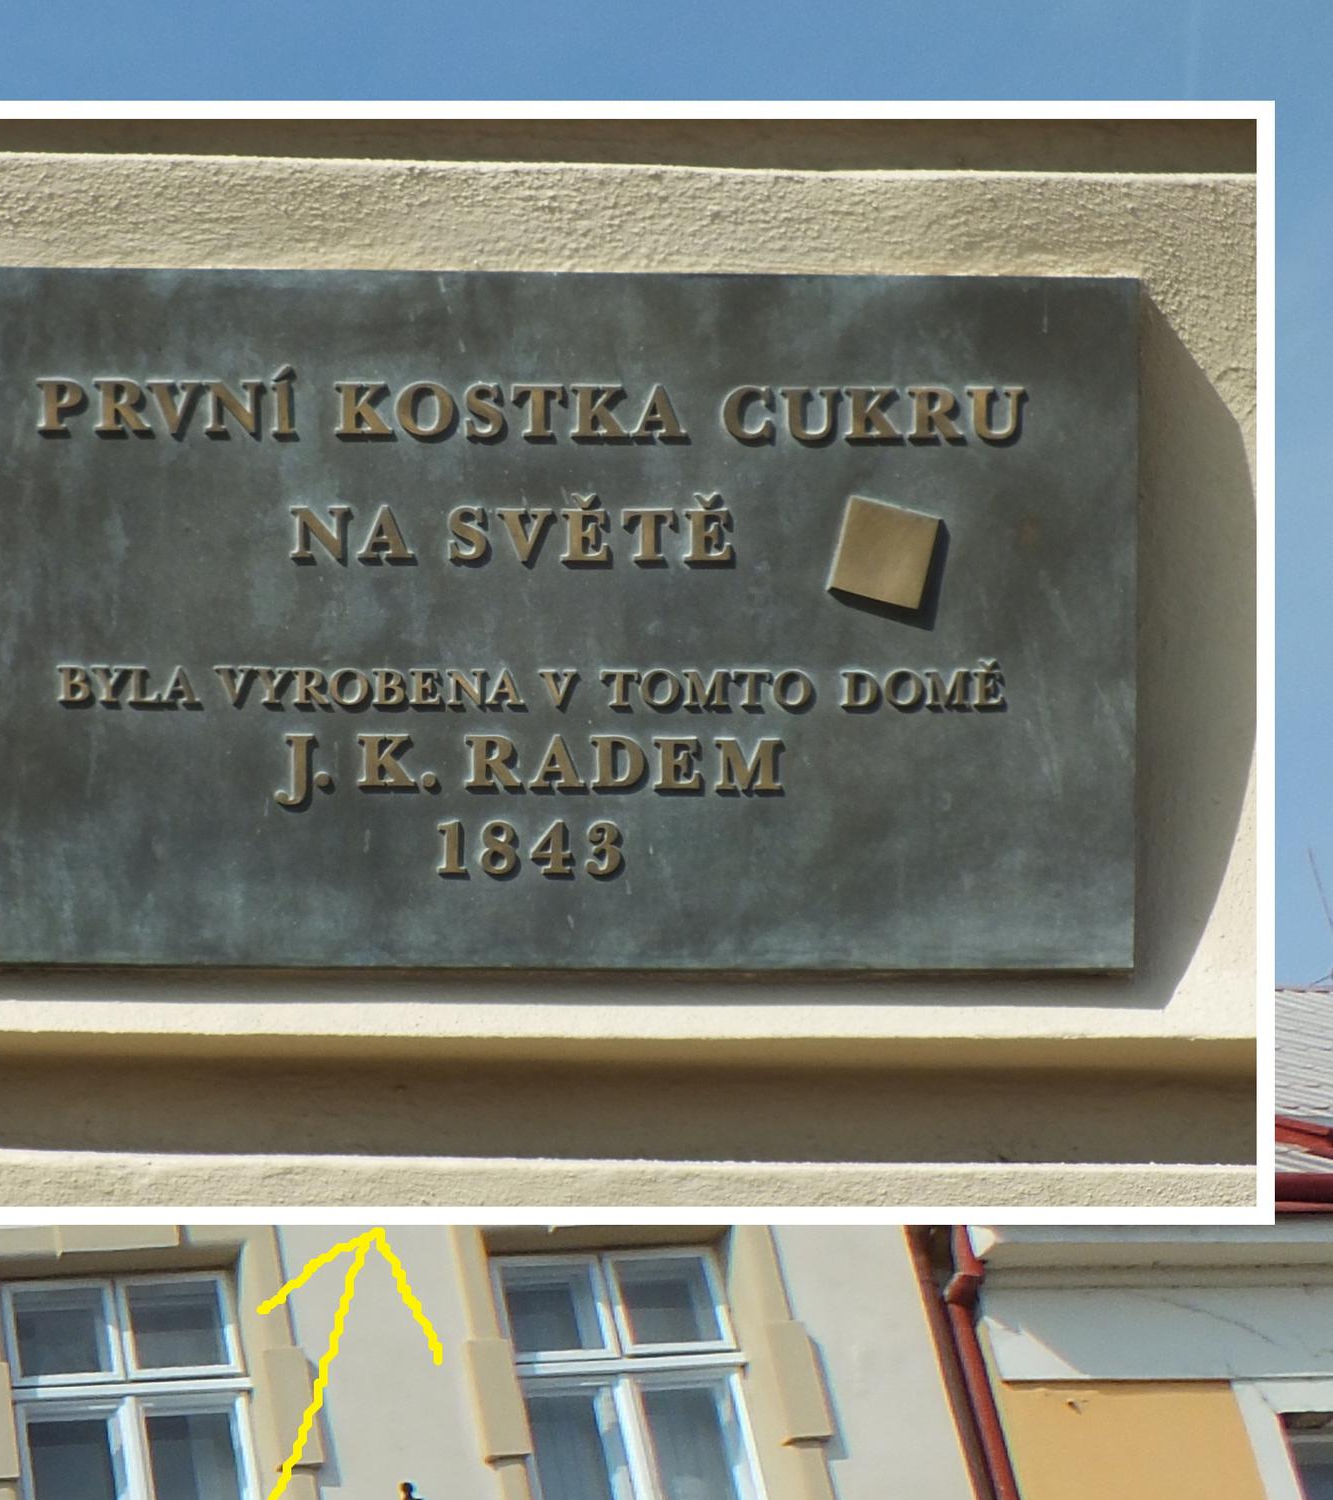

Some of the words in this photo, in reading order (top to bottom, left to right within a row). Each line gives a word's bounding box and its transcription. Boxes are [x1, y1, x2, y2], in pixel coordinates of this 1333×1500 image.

[36, 364, 296, 440] PRVNÍ
[334, 380, 688, 443] KOSTKA
[721, 385, 1027, 445] CUKRU
[290, 504, 416, 564] NA
[447, 491, 734, 567] SVĚTĚ
[56, 664, 202, 708] BYLA
[213, 665, 526, 711] VYROBENA
[538, 669, 579, 710] V
[600, 668, 815, 713] TOMTO
[840, 658, 1006, 713] DOMĚ
[274, 733, 333, 809] J.
[357, 734, 439, 791] K.
[464, 734, 785, 794] RADEM
[436, 819, 625, 879] 1843
